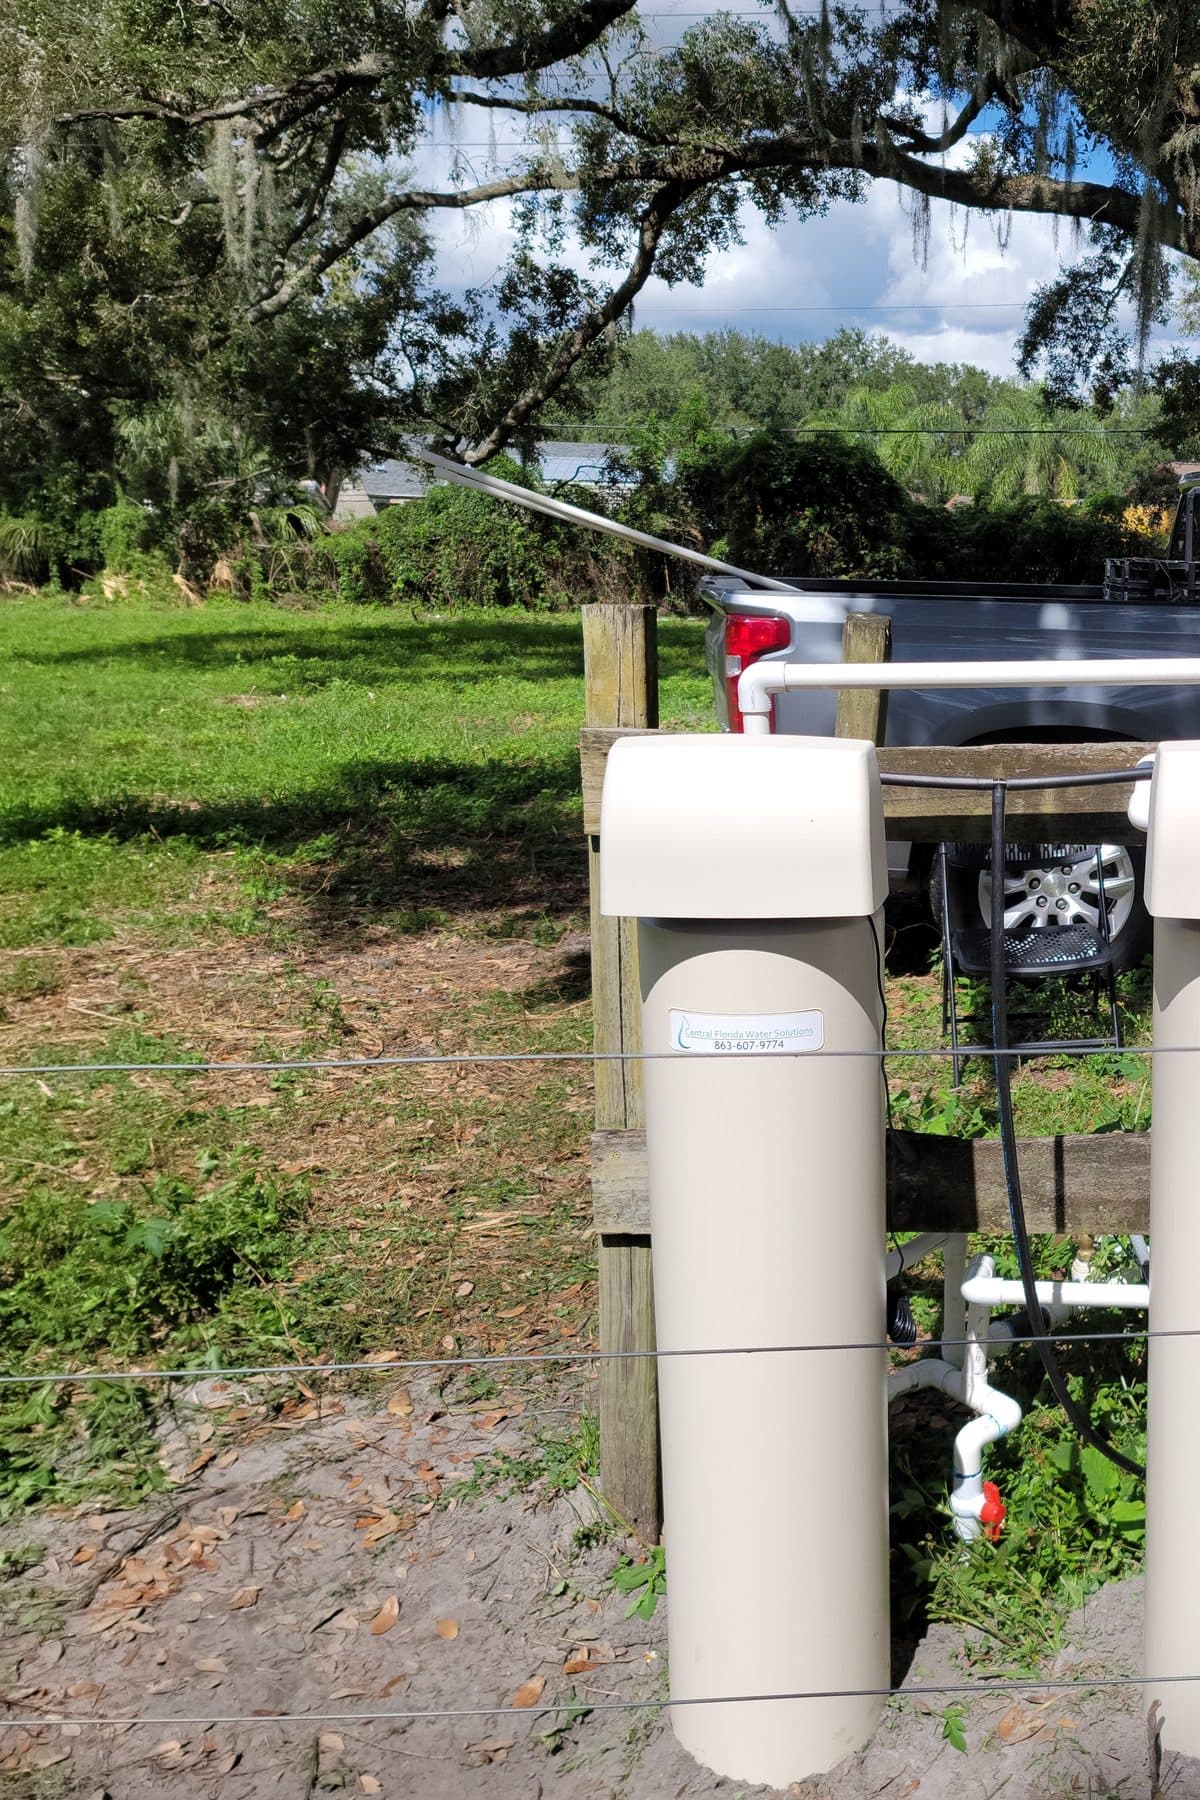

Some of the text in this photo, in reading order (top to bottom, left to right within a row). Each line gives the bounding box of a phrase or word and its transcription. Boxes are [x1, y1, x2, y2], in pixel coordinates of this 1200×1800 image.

[684, 1027, 814, 1039] Central Florida Water Solutions
[714, 1040, 784, 1051] 863-607-9774
